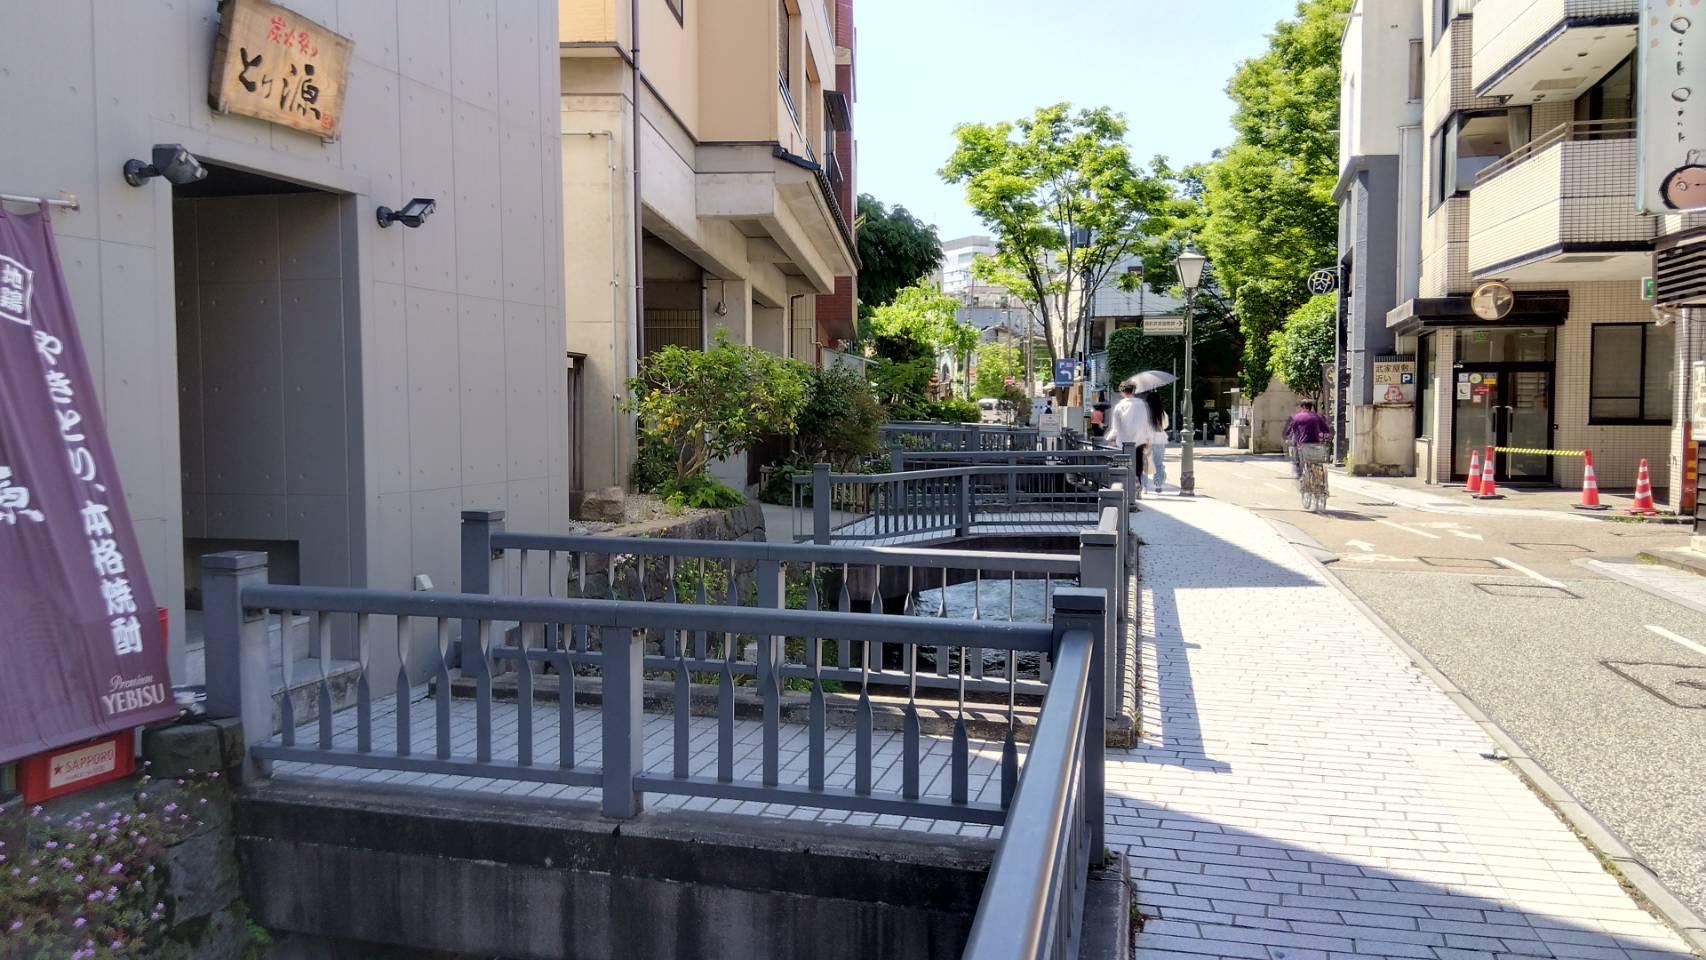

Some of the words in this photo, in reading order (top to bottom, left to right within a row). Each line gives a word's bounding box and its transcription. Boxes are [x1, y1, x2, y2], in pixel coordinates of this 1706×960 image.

[1402, 374, 1411, 383] P
[109, 674, 154, 691] Premium
[102, 683, 165, 715] YEBISU
[64, 749, 113, 773] SAPPORO
